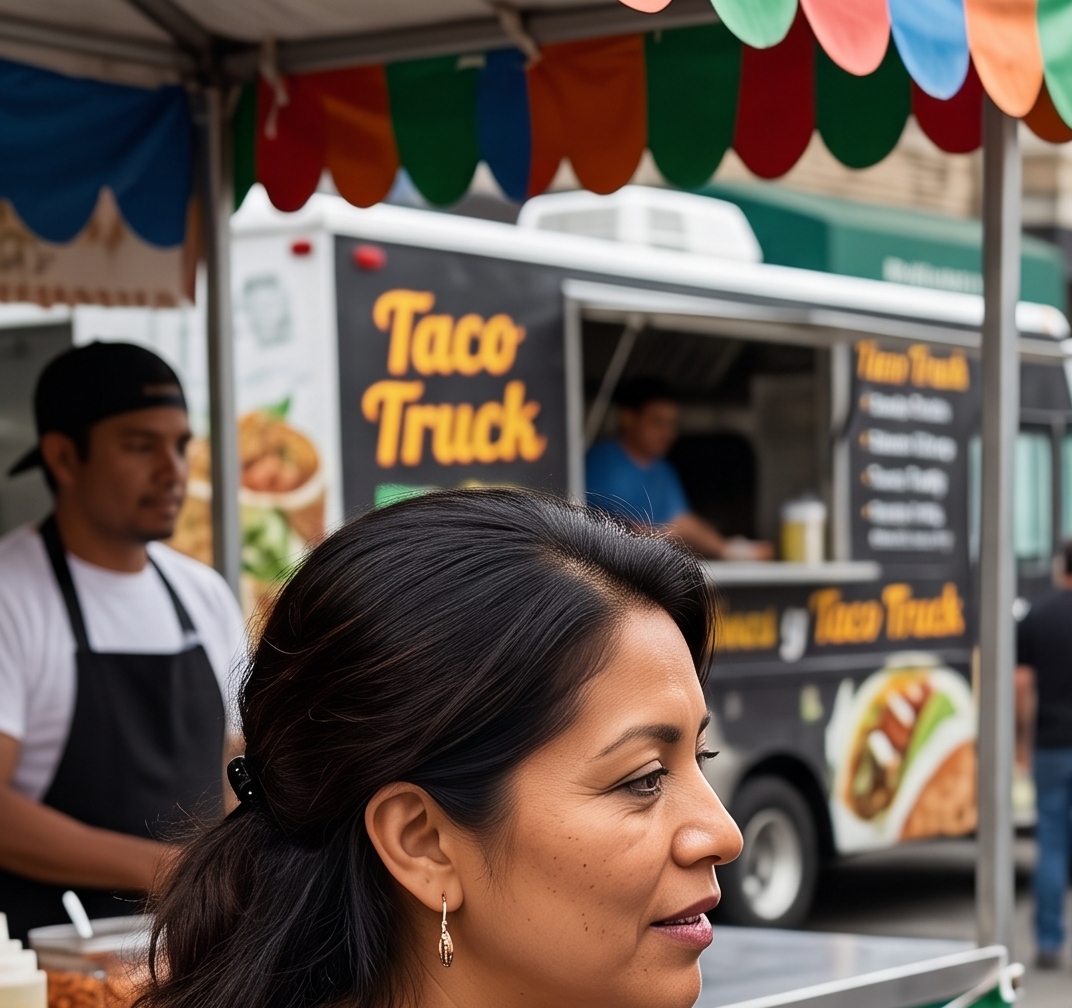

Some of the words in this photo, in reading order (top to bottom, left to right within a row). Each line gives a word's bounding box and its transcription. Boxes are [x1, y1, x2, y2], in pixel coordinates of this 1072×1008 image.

[373, 288, 526, 377] Taco
[361, 379, 546, 470] Truck
[882, 582, 965, 641] Truck
